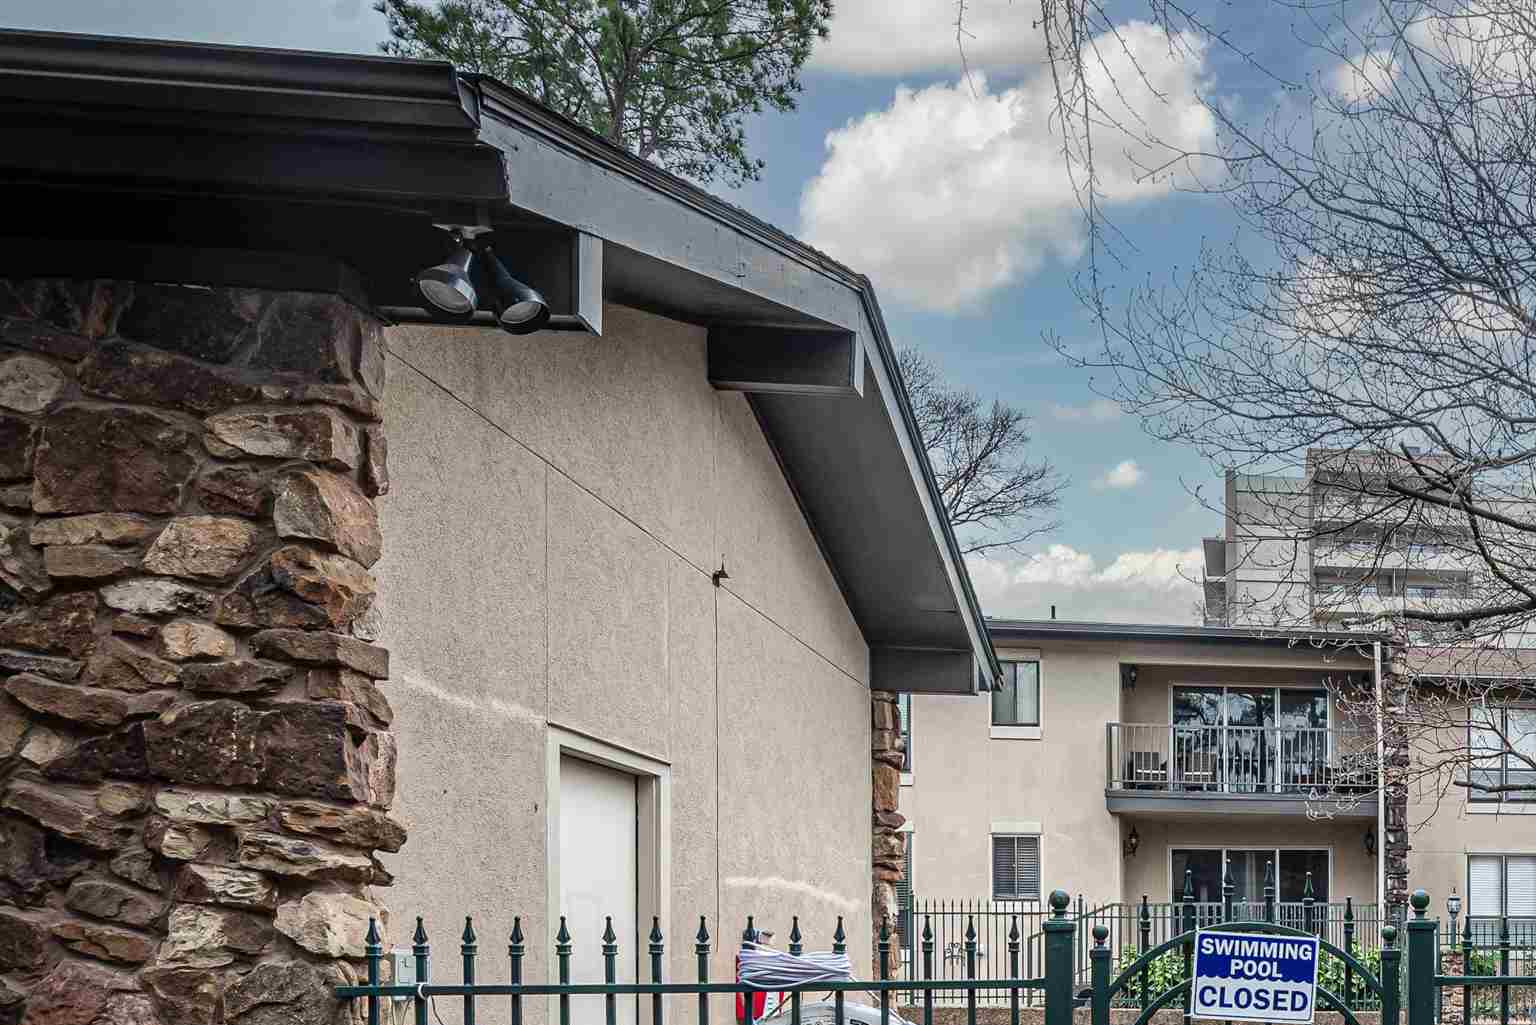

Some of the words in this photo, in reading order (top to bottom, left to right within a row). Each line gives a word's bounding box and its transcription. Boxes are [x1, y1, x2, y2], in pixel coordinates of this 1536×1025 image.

[1201, 938, 1312, 960] SWIMMING
[1230, 959, 1282, 977] POOL
[1199, 986, 1308, 1011] CLOSED
